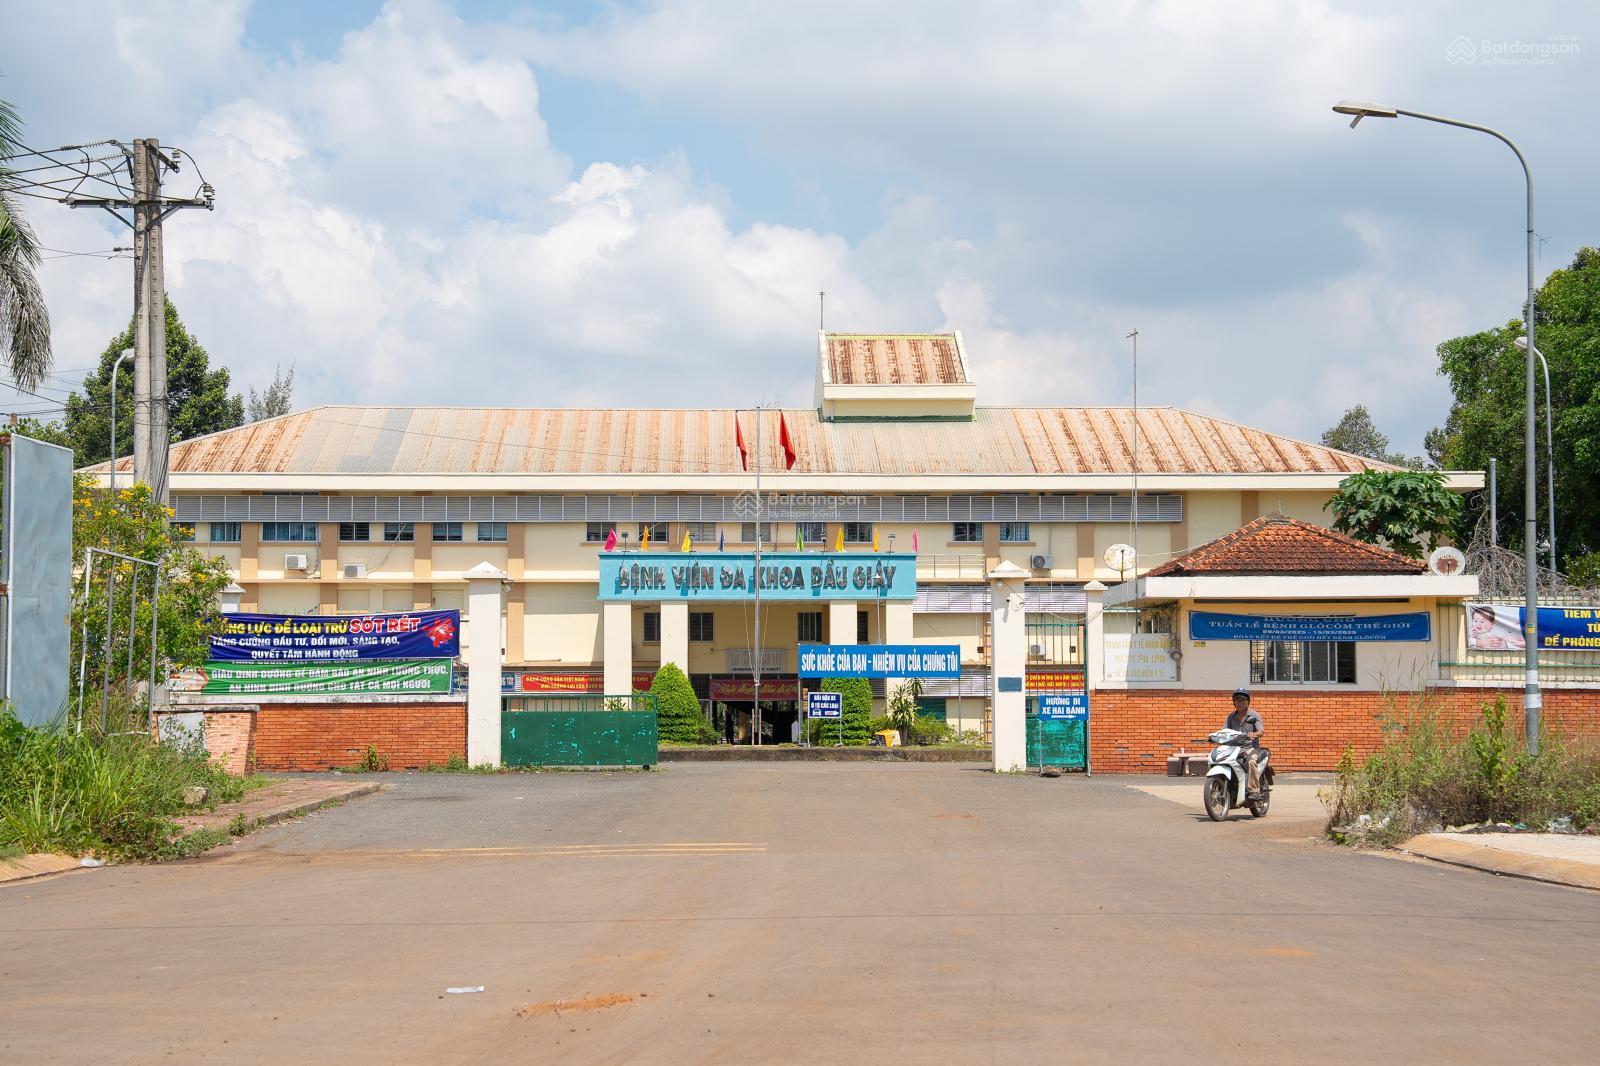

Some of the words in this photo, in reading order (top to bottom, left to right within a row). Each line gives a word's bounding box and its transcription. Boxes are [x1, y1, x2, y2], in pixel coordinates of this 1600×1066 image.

[619, 561, 666, 595] BỆNH
[671, 560, 714, 595] VIỆN
[720, 566, 746, 590] ĐA
[754, 566, 805, 590] KHOA
[248, 622, 272, 636] LỰC
[274, 618, 292, 634] ĐỂ
[293, 623, 321, 636] LOẠI
[324, 620, 348, 634] TRỪ
[350, 615, 385, 633] SỐT
[387, 615, 421, 632] RÉT
[1263, 621, 1297, 629] BỆNH
[239, 636, 271, 646] CƯỜNG
[311, 635, 327, 646] ĐỔI
[352, 636, 378, 645] SÁNG
[1544, 634, 1560, 646] ĐỂ
[251, 649, 280, 659] QUYẾT
[282, 649, 302, 658] TÂM
[305, 649, 330, 658] HÀNH
[333, 649, 359, 659] ĐỘNG
[802, 649, 815, 671] SỨC
[817, 648, 835, 671] KHỎE
[837, 648, 850, 671] CỦA
[852, 654, 867, 674] BẠN
[872, 651, 895, 674] NHIỆM
[896, 654, 906, 674] VỤ
[907, 649, 921, 671] CỦA
[922, 651, 946, 671] CHÚNG
[947, 651, 958, 671] TÔI
[383, 680, 401, 690] MỌI
[1046, 696, 1070, 705] HƯỚNG
[1073, 697, 1081, 705] ĐI
[1066, 705, 1085, 714] BÁNH
